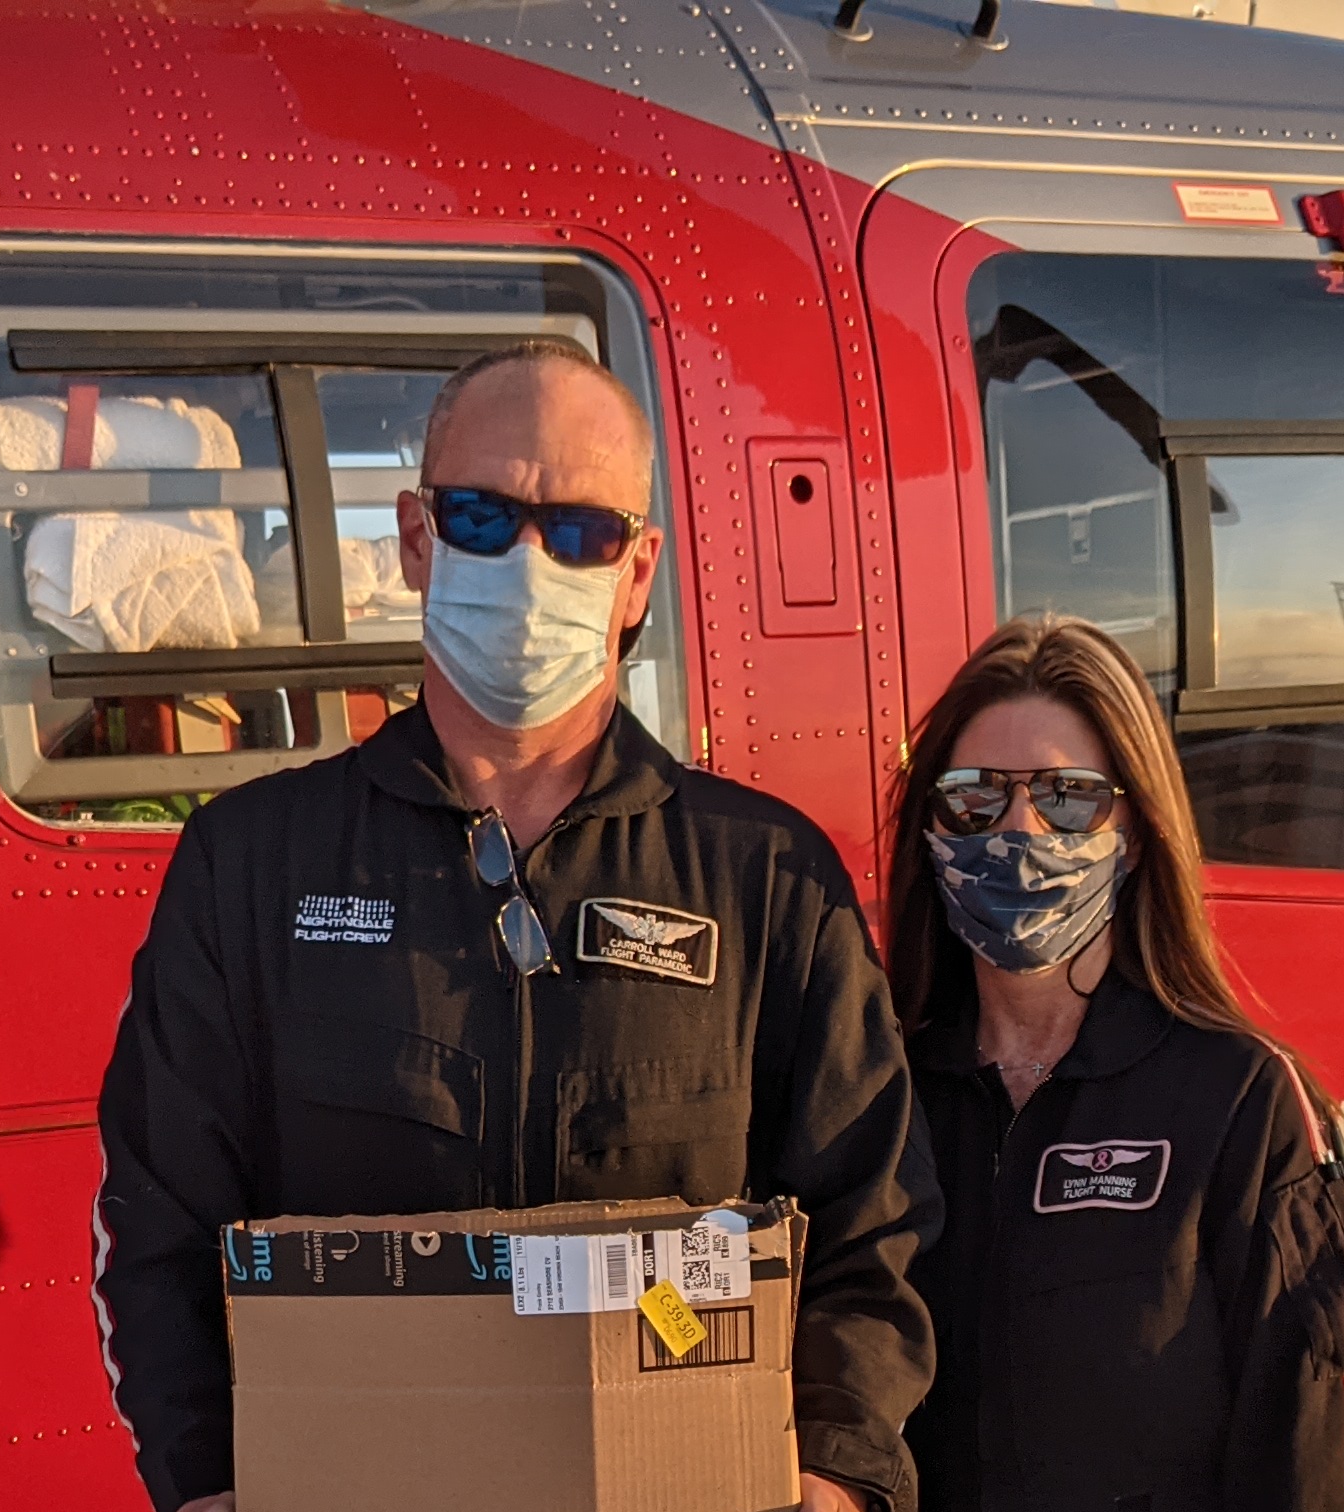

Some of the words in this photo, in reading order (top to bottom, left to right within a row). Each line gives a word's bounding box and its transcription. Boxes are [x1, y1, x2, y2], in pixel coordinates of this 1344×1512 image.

[294, 928, 342, 942] FLIGHT
[343, 931, 391, 943] CREW
[609, 938, 655, 955] CARROLL
[658, 947, 686, 963] WARD
[600, 946, 636, 960] FLIGHT
[639, 953, 693, 974] PARAMEDIC
[1063, 1177, 1087, 1189] LYNN
[1089, 1175, 1137, 1188] MANNING
[1063, 1186, 1095, 1199] FLIGHT
[1099, 1186, 1133, 1198] NURSE
[644, 1249, 654, 1276] DOR1
[714, 1272, 723, 1290] RIC2
[517, 1295, 525, 1311] LEX2
